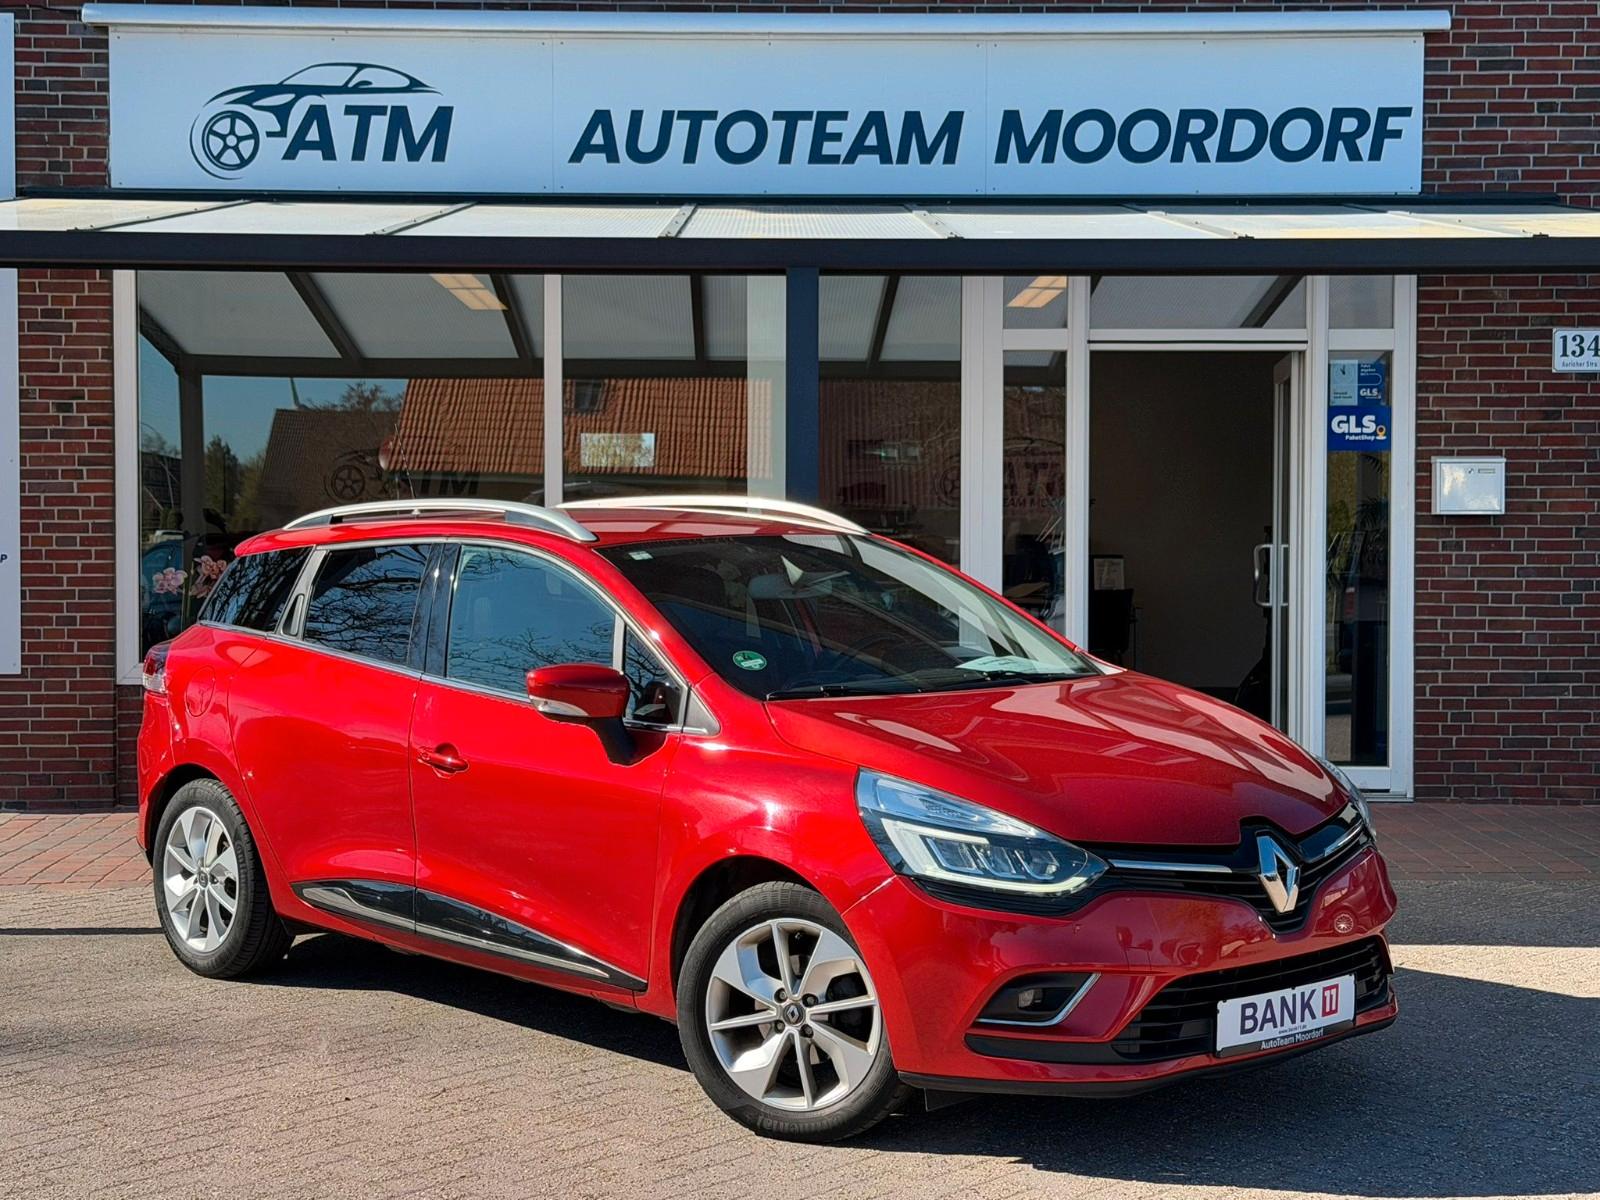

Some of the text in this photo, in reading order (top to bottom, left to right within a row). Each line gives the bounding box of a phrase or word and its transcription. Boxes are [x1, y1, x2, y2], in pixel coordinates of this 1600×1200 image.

[281, 104, 454, 162] ATM
[567, 106, 1413, 165] AUTOTEAM MOORDORF
[1559, 334, 1600, 358] 134
[1360, 387, 1378, 397] GLS
[1331, 414, 1377, 434] GLS
[1240, 988, 1317, 1036] BANK
[1260, 1028, 1324, 1051] AutoTeam Moordorf
